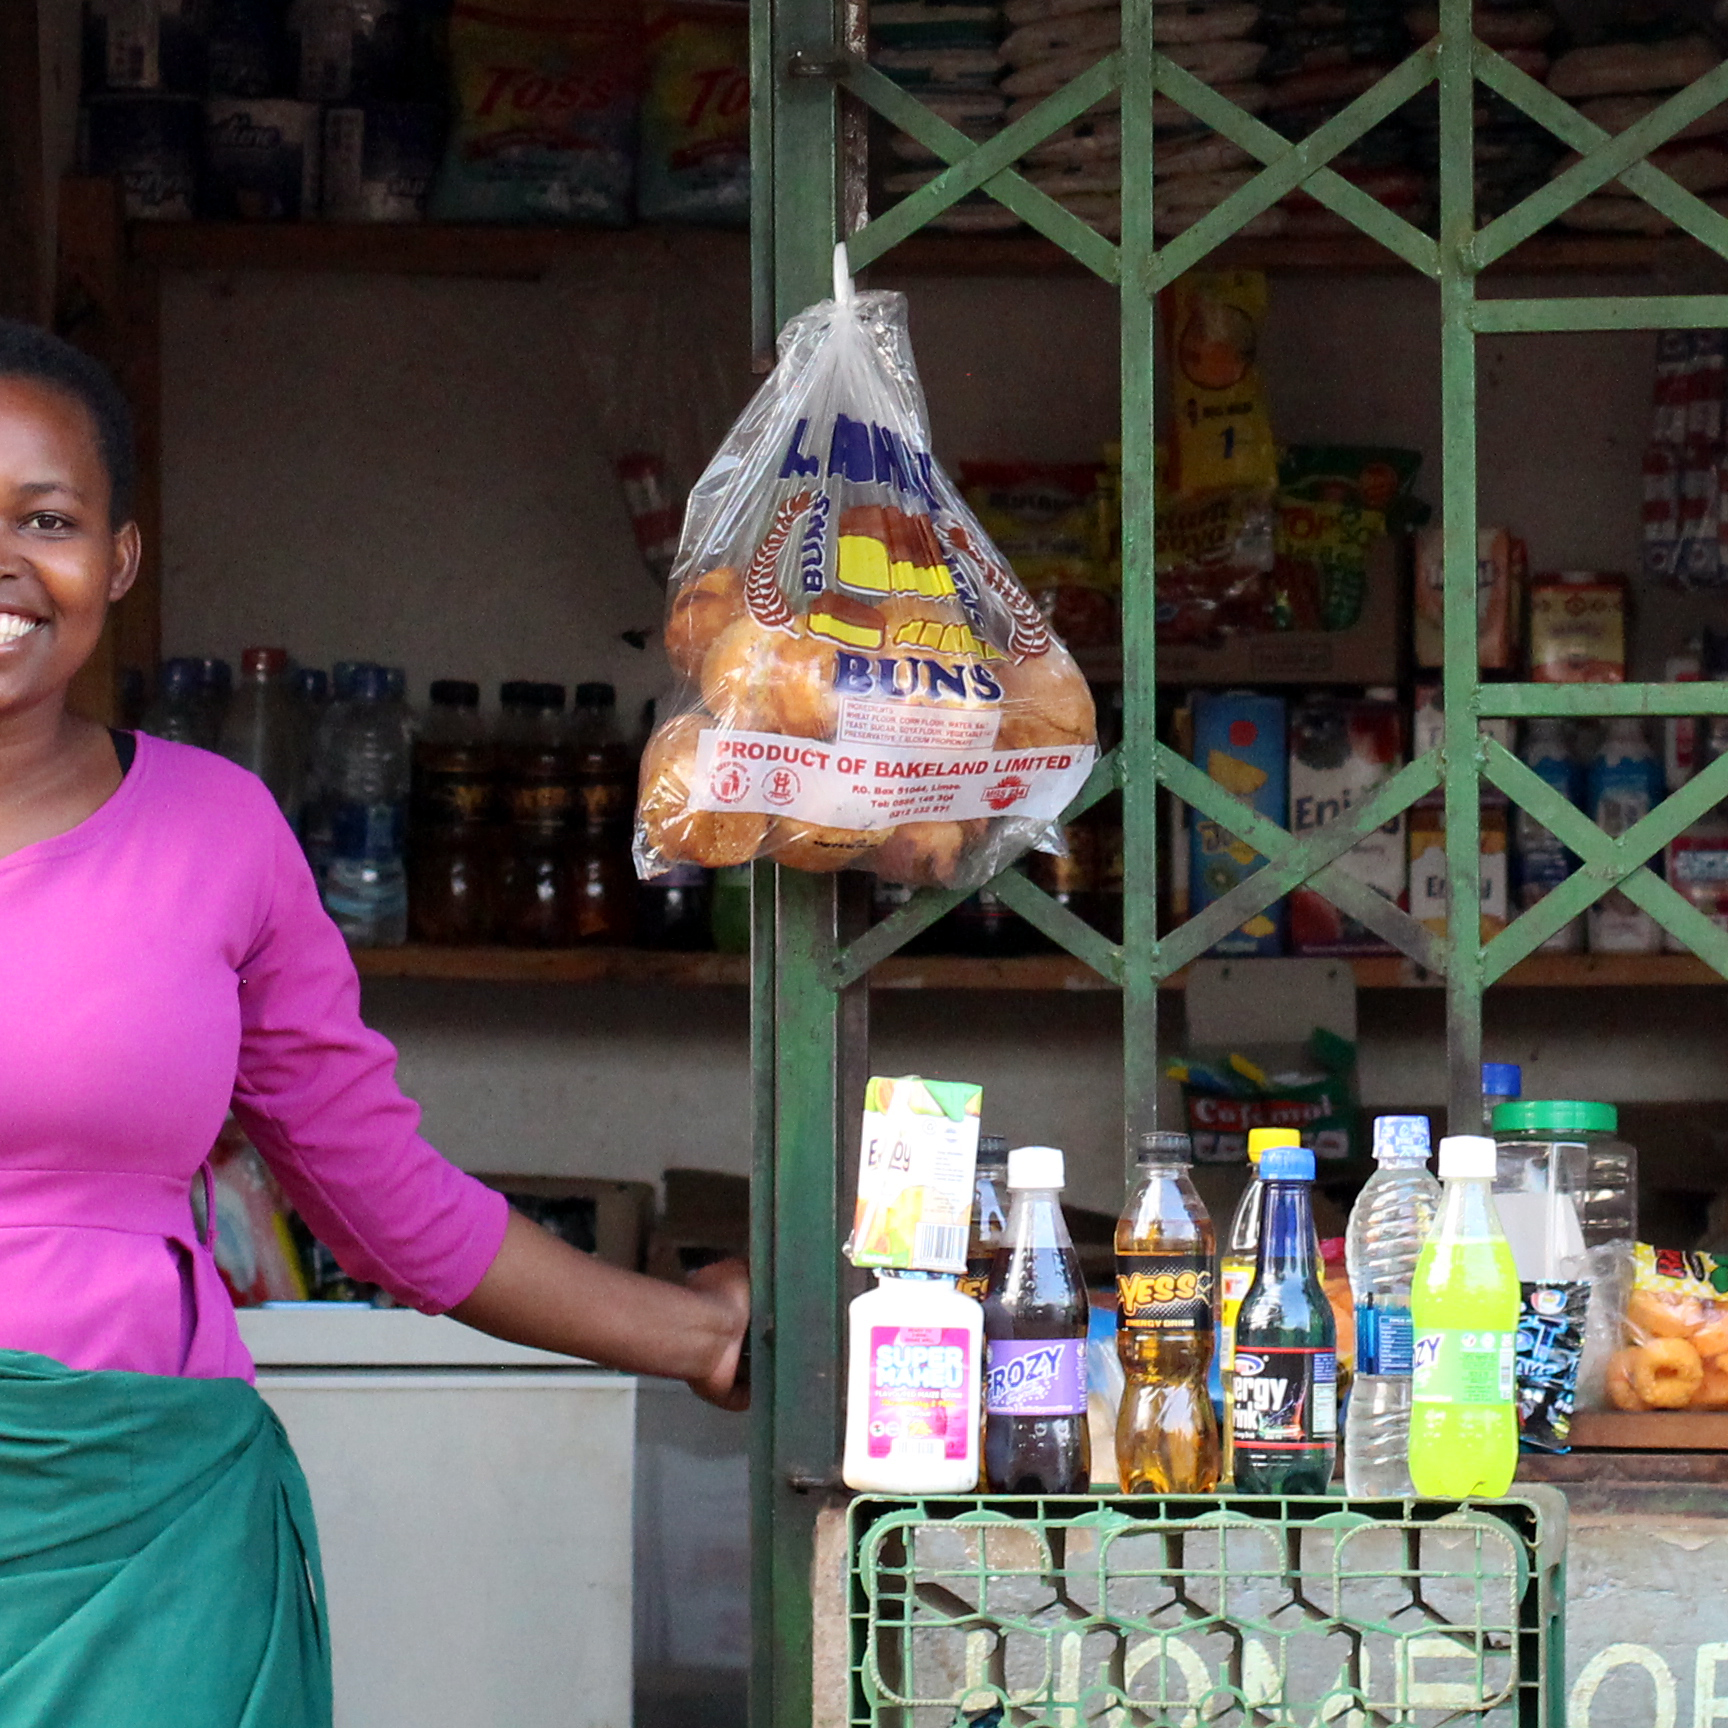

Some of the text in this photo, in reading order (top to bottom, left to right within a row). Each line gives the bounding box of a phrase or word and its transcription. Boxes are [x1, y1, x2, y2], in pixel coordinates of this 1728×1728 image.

[684, 65, 751, 128] TO
[832, 650, 1002, 703] BUNS
[717, 740, 1071, 779] PRODUCT OF BAKELAND LIMITED
[1118, 1271, 1199, 1316] YESS
[875, 1366, 964, 1389] MAHEU
[876, 1345, 964, 1369] SUPER
